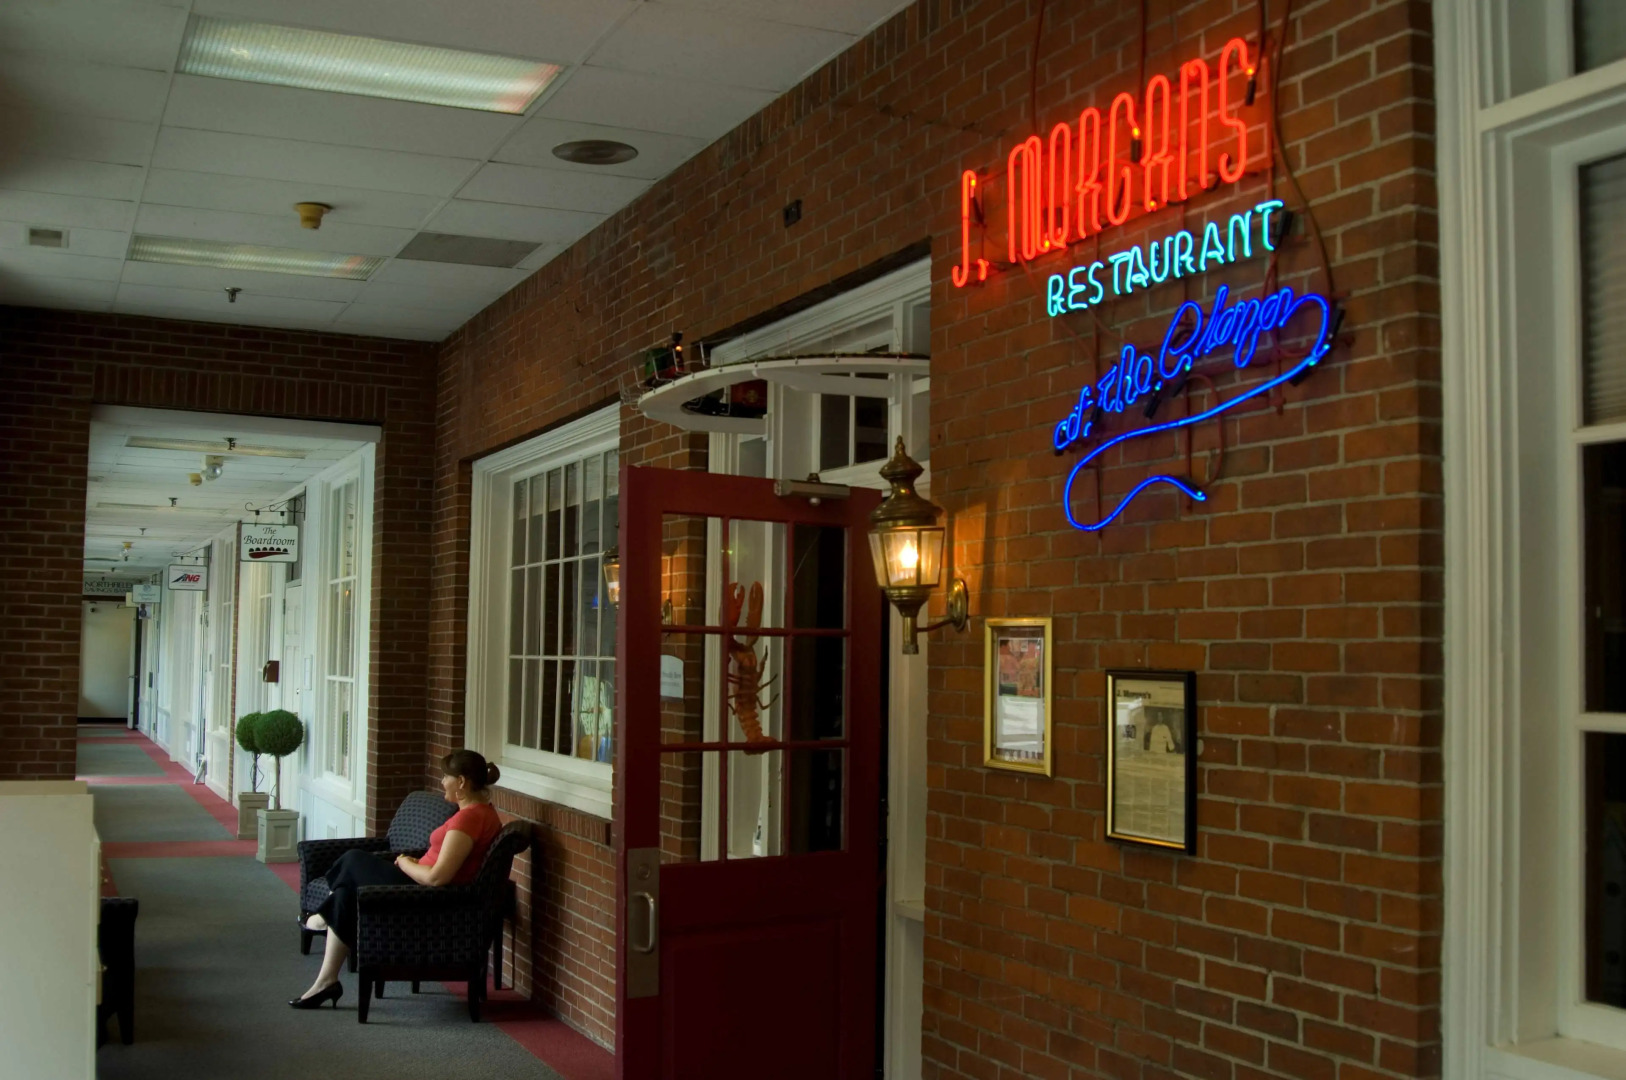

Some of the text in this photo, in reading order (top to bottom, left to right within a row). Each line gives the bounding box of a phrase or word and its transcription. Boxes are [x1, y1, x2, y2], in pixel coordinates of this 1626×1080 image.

[952, 37, 1256, 289] J. MORGANS
[1046, 199, 1284, 317] RESTAURANT
[1053, 385, 1093, 450] at
[1097, 344, 1162, 413] the
[243, 535, 296, 546] Boardroom
